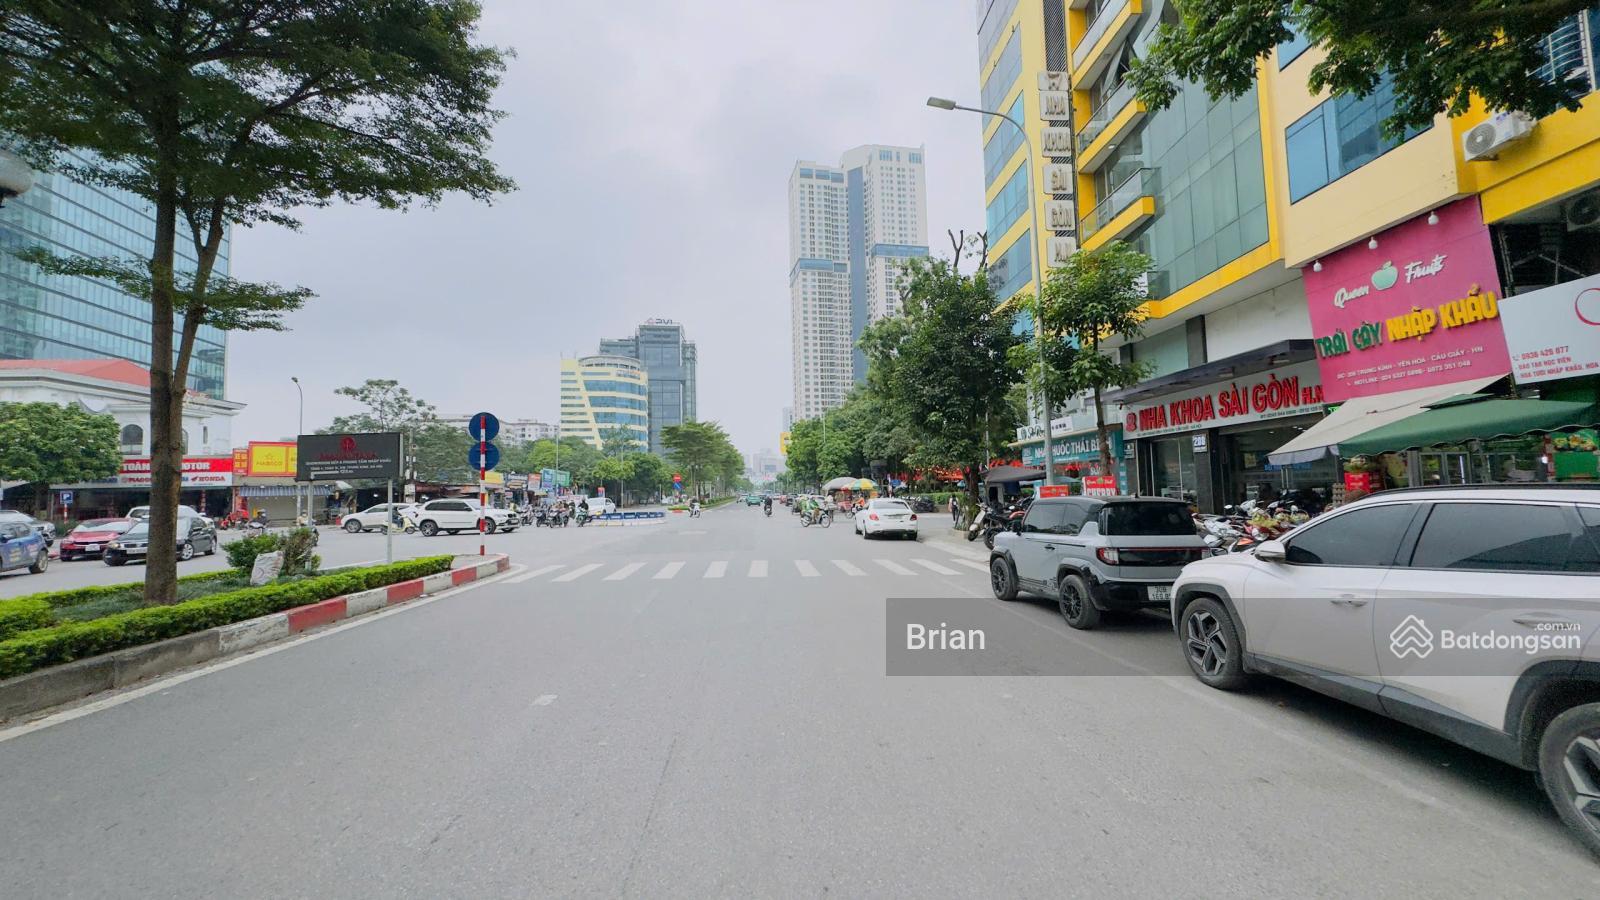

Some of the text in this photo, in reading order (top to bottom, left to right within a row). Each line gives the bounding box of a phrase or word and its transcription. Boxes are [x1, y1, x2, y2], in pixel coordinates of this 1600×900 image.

[1334, 254, 1448, 309] Queen Fruit
[1386, 305, 1438, 343] NHẬP
[1438, 283, 1500, 330] KHẨU
[1139, 404, 1168, 432] NHA
[1169, 393, 1216, 426] KHOA
[1217, 382, 1250, 418] SÀI
[1252, 373, 1299, 413] GÒN
[1052, 440, 1070, 457] HUỐC
[1071, 436, 1090, 454] THÁI
